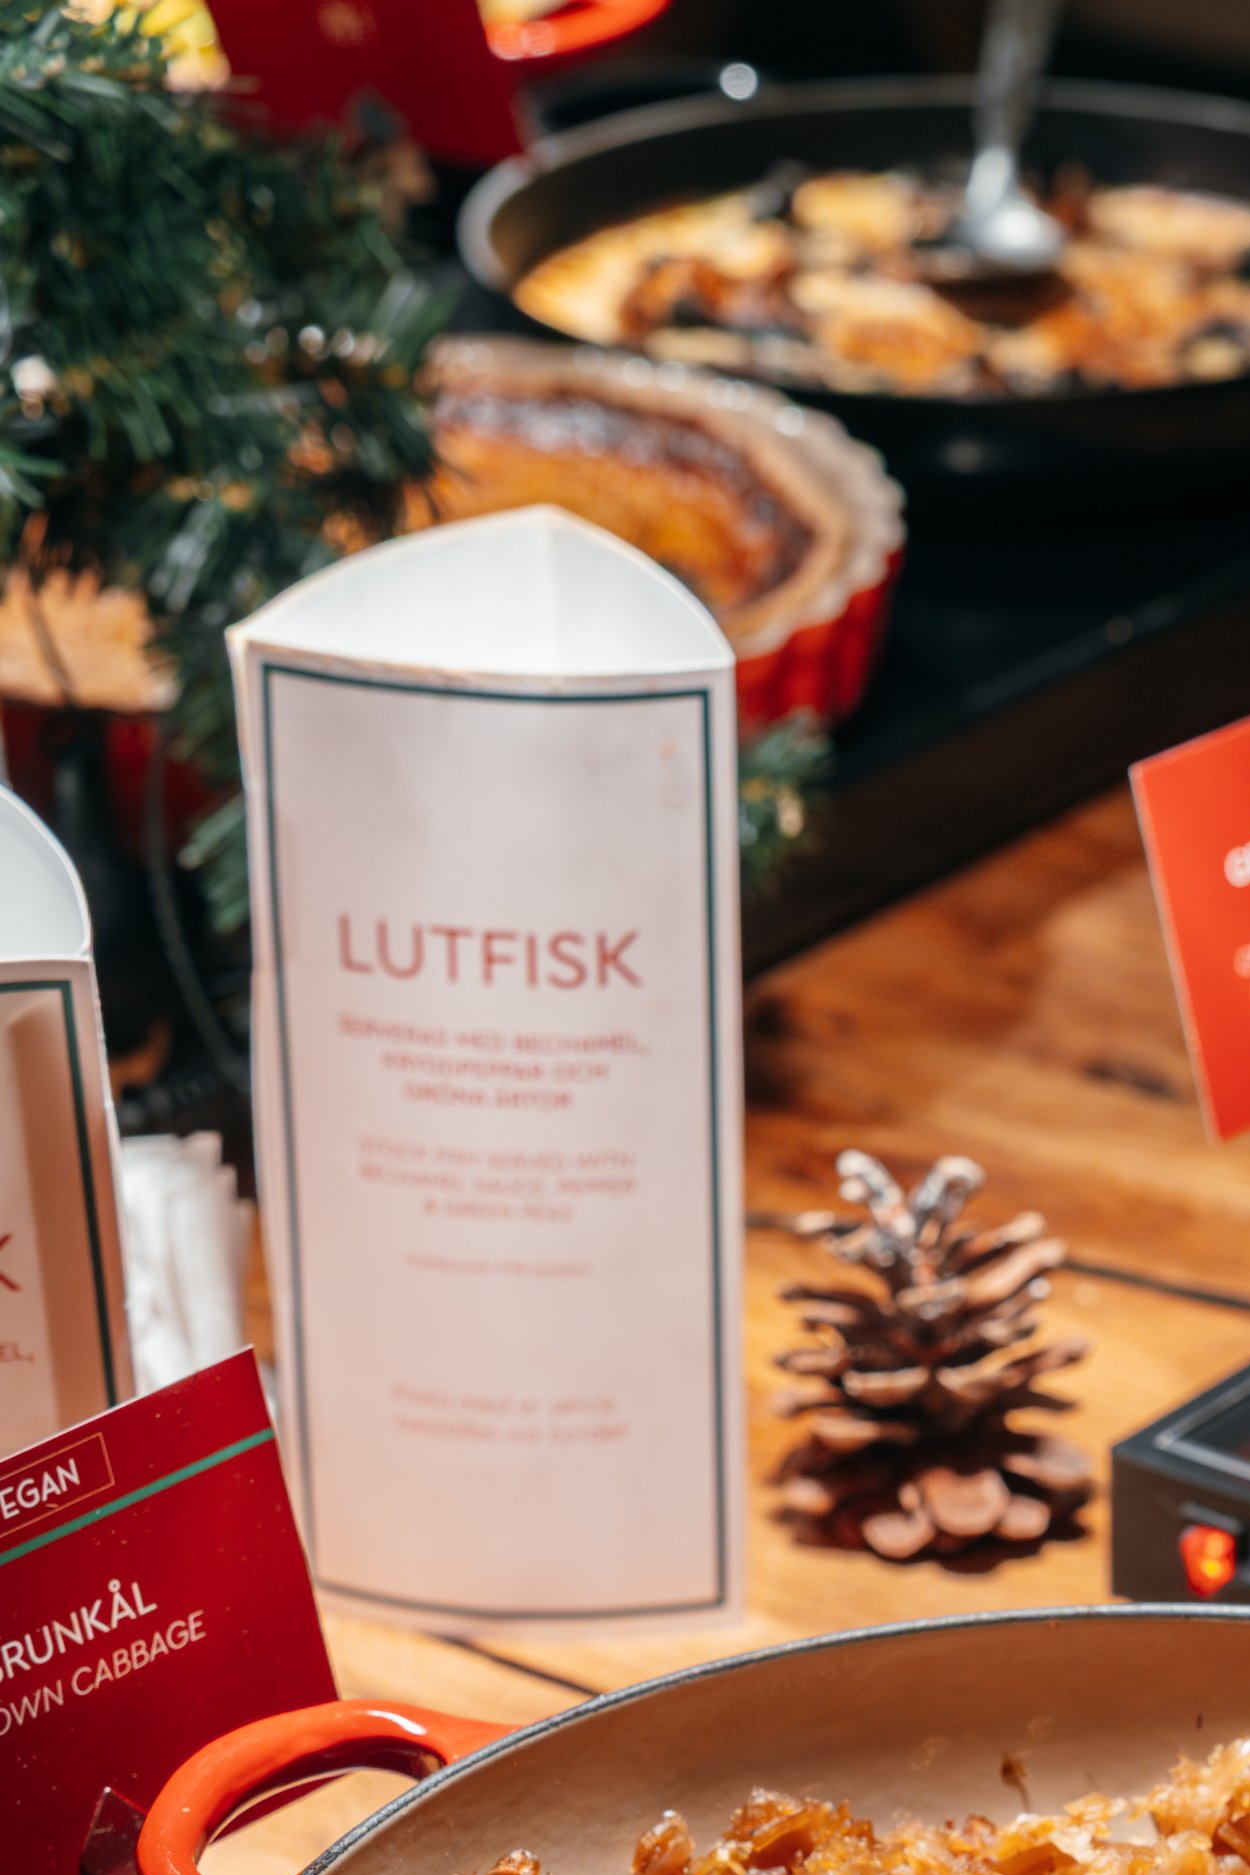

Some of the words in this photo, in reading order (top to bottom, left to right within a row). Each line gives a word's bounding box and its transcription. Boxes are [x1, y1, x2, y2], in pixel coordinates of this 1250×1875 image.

[338, 911, 644, 990] LUTFISK
[0, 1579, 157, 1683] RUNKÅL
[71, 1609, 207, 1696] CABBAGE
